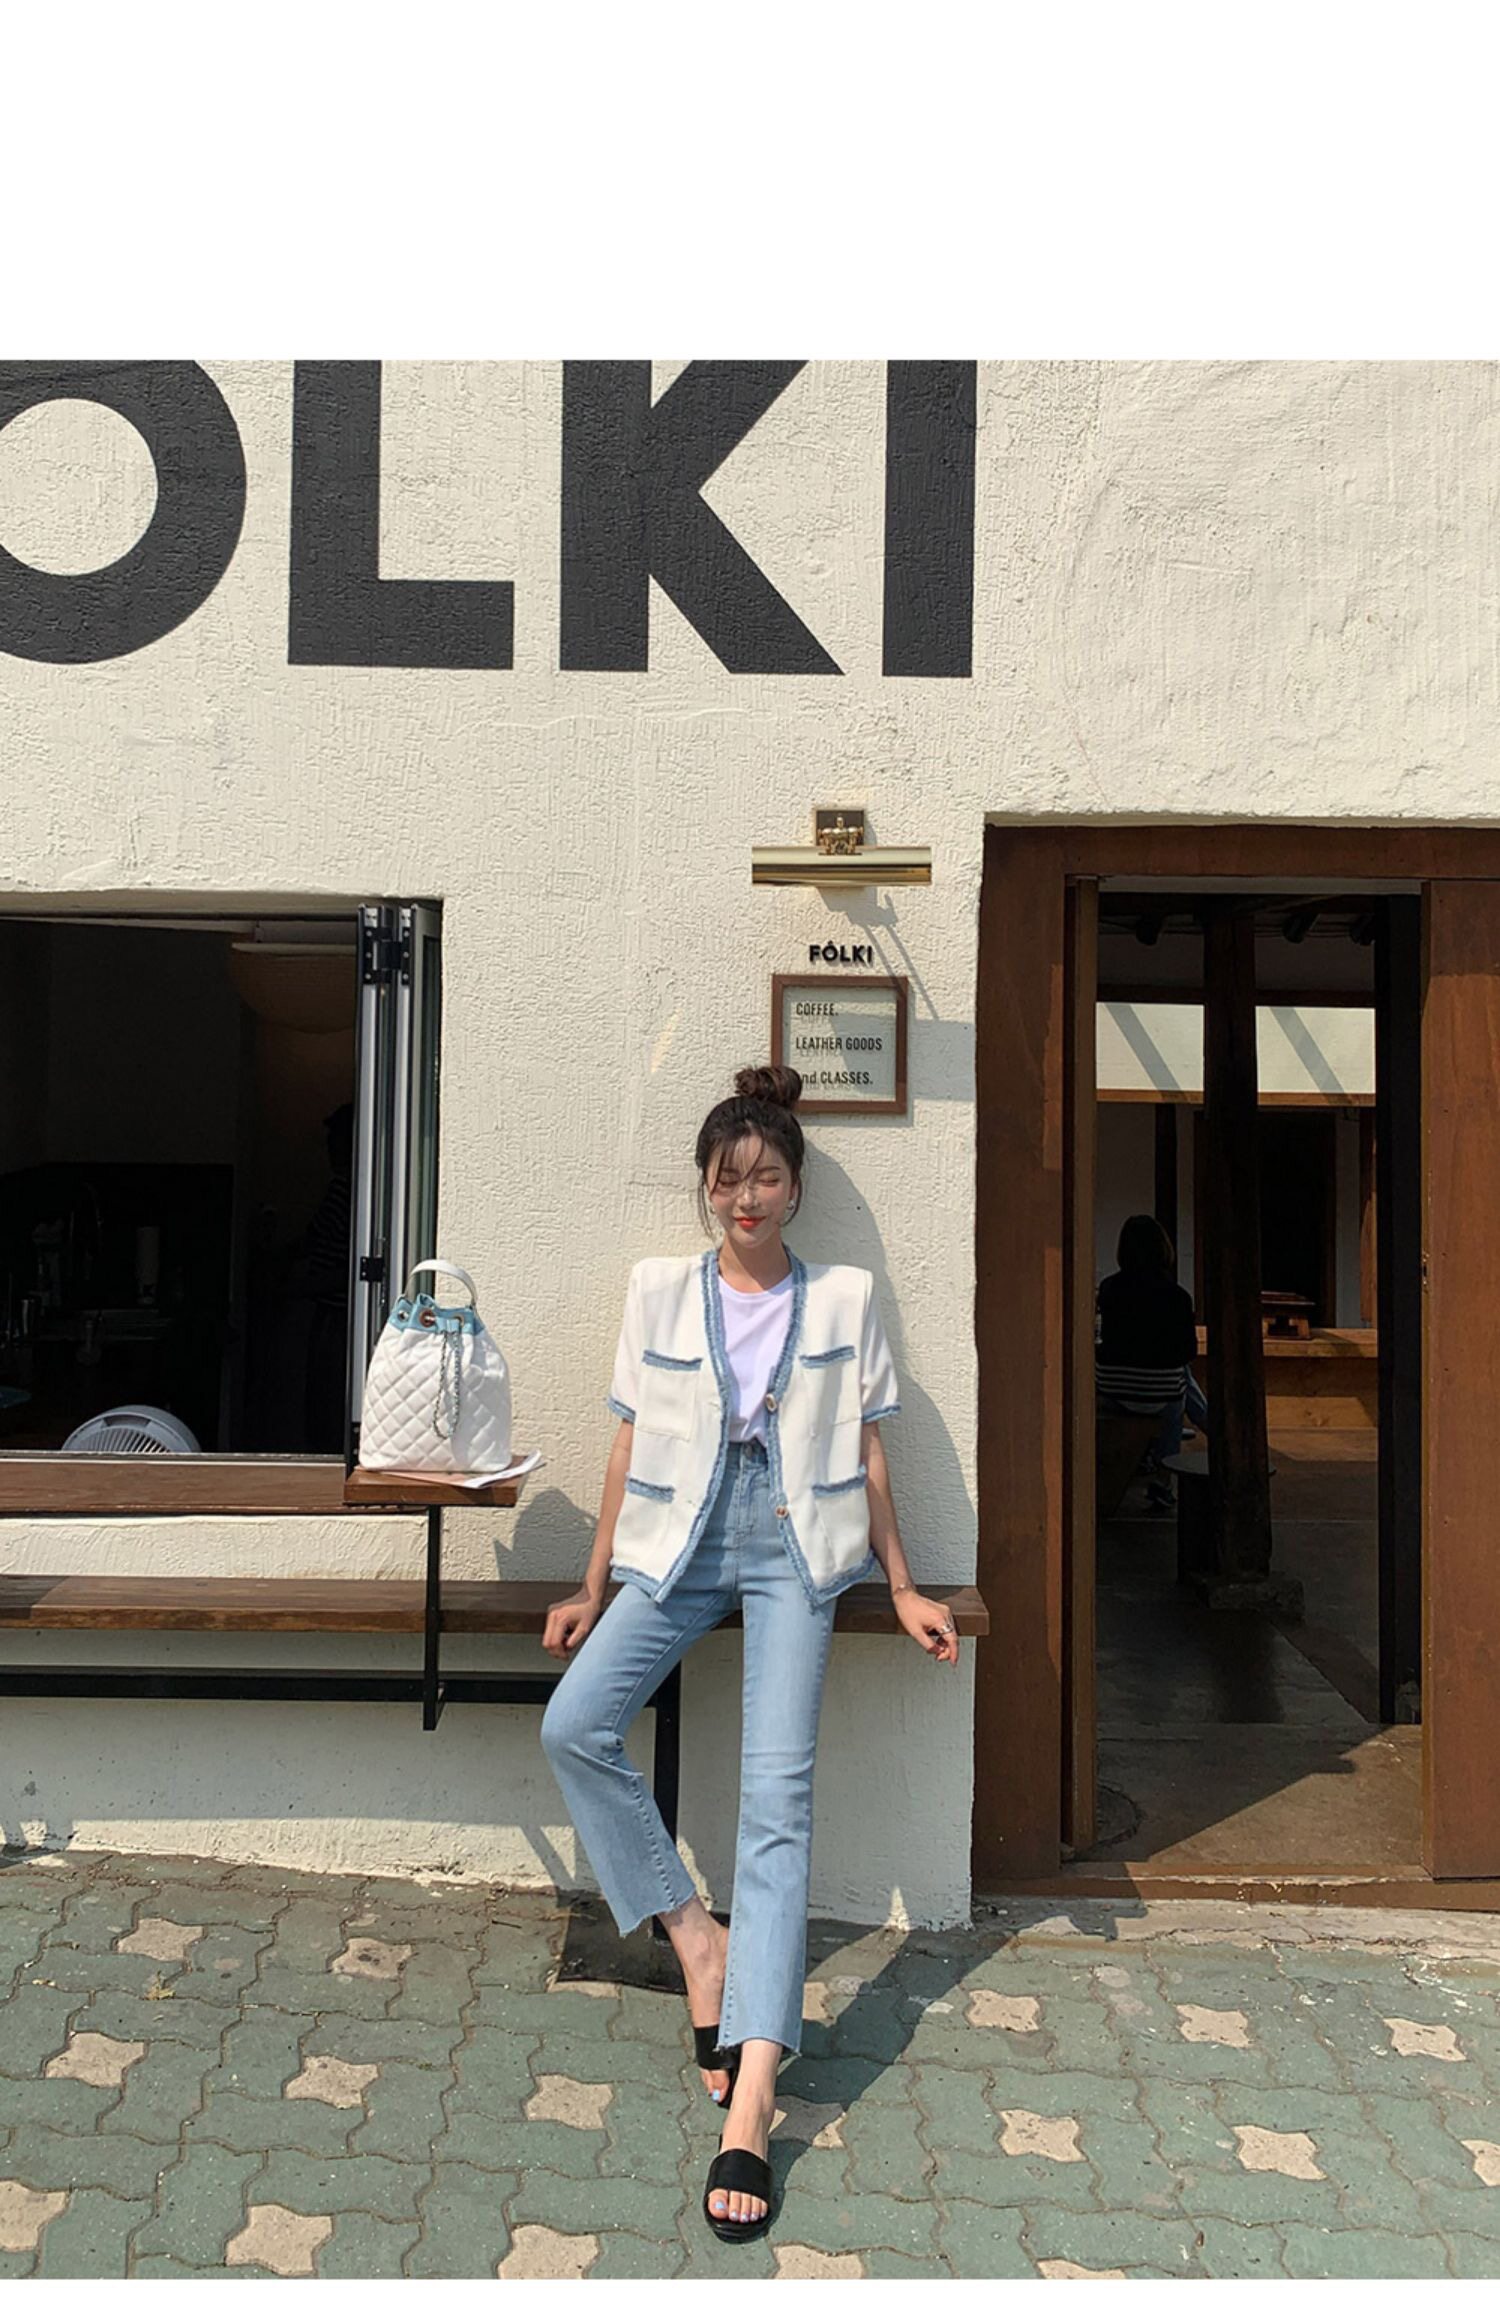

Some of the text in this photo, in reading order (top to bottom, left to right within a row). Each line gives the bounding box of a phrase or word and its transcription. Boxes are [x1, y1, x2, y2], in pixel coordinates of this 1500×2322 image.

[796, 1003, 839, 1017] COFFEE.
[796, 1037, 883, 1051] LEATHER GOODS
[801, 1070, 873, 1085] nd CLASSES.
